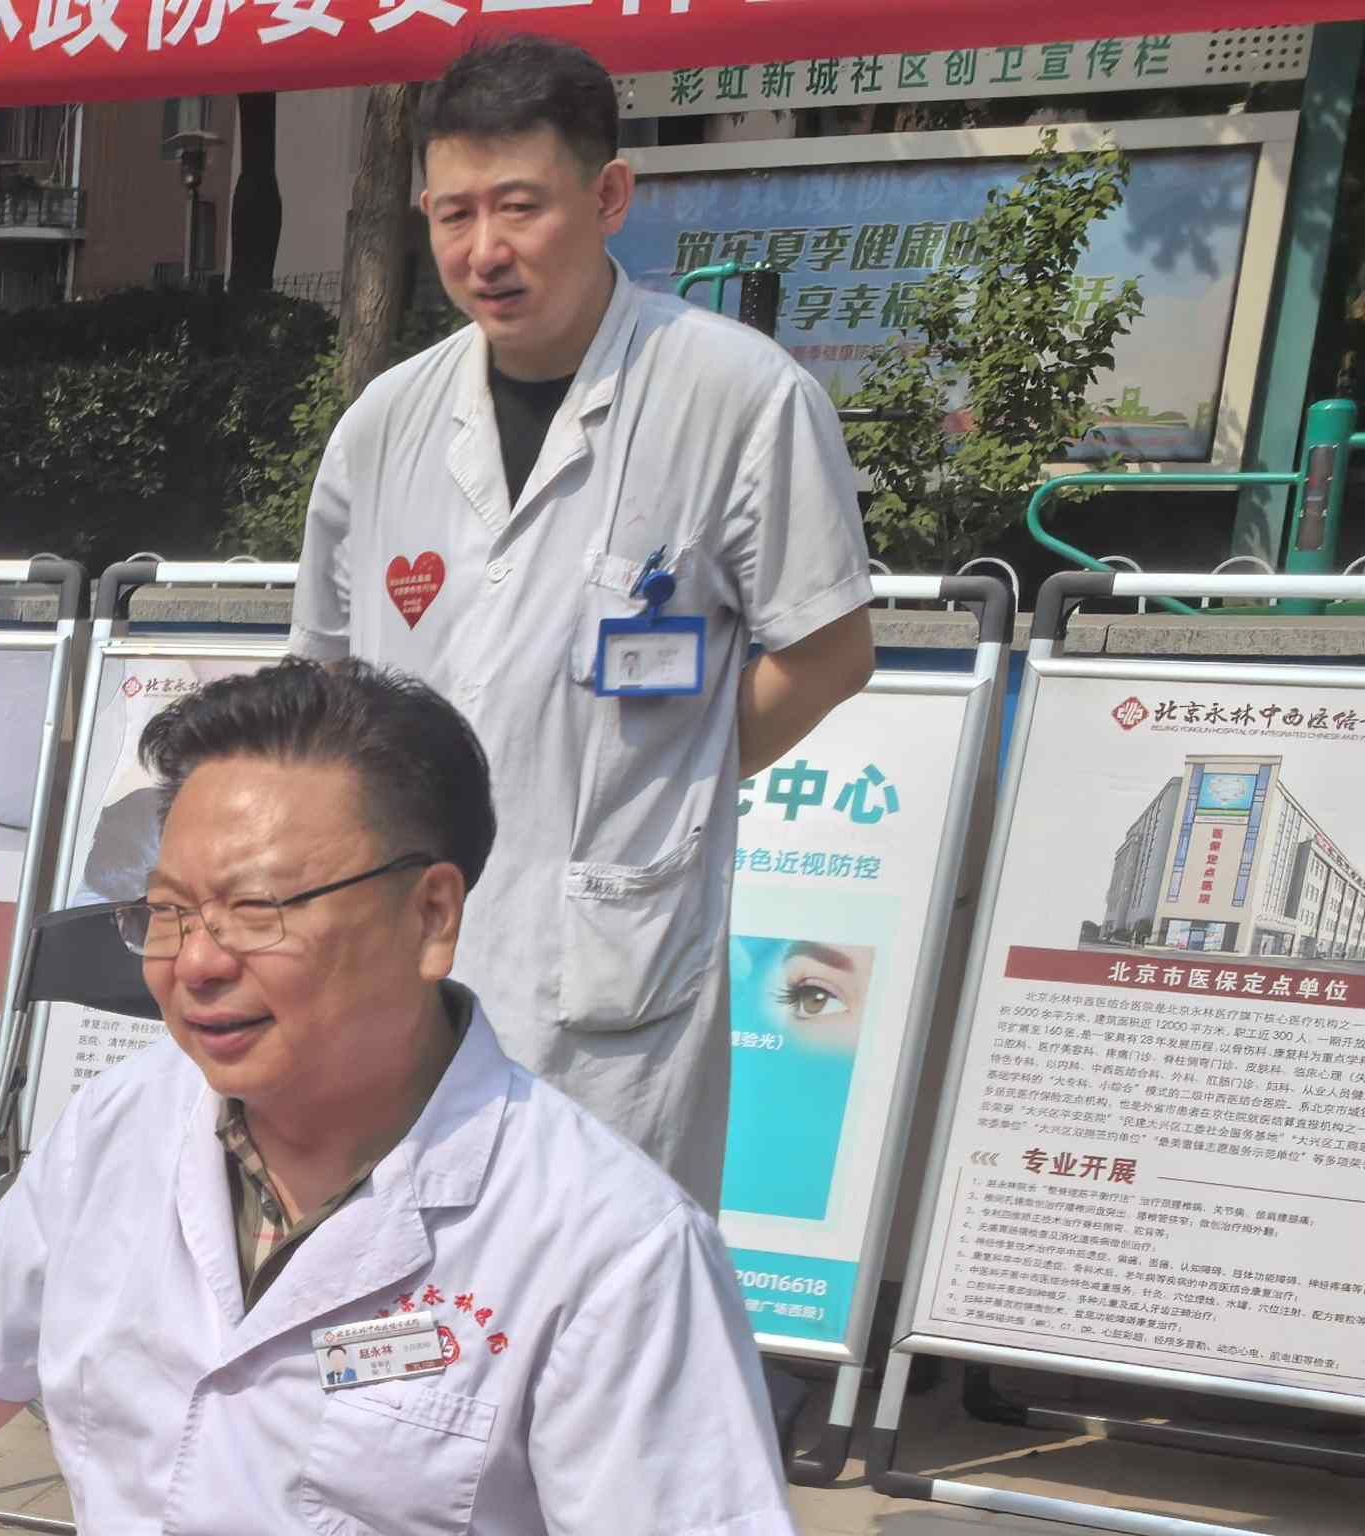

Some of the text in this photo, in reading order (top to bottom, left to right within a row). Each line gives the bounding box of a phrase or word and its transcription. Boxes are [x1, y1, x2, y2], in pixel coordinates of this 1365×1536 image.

[671, 35, 1172, 105] 彩虹新城社区创卫宣传栏
[1107, 960, 1350, 1002] 北京市医保定点单位
[1022, 1148, 1137, 1184] 专业开展
